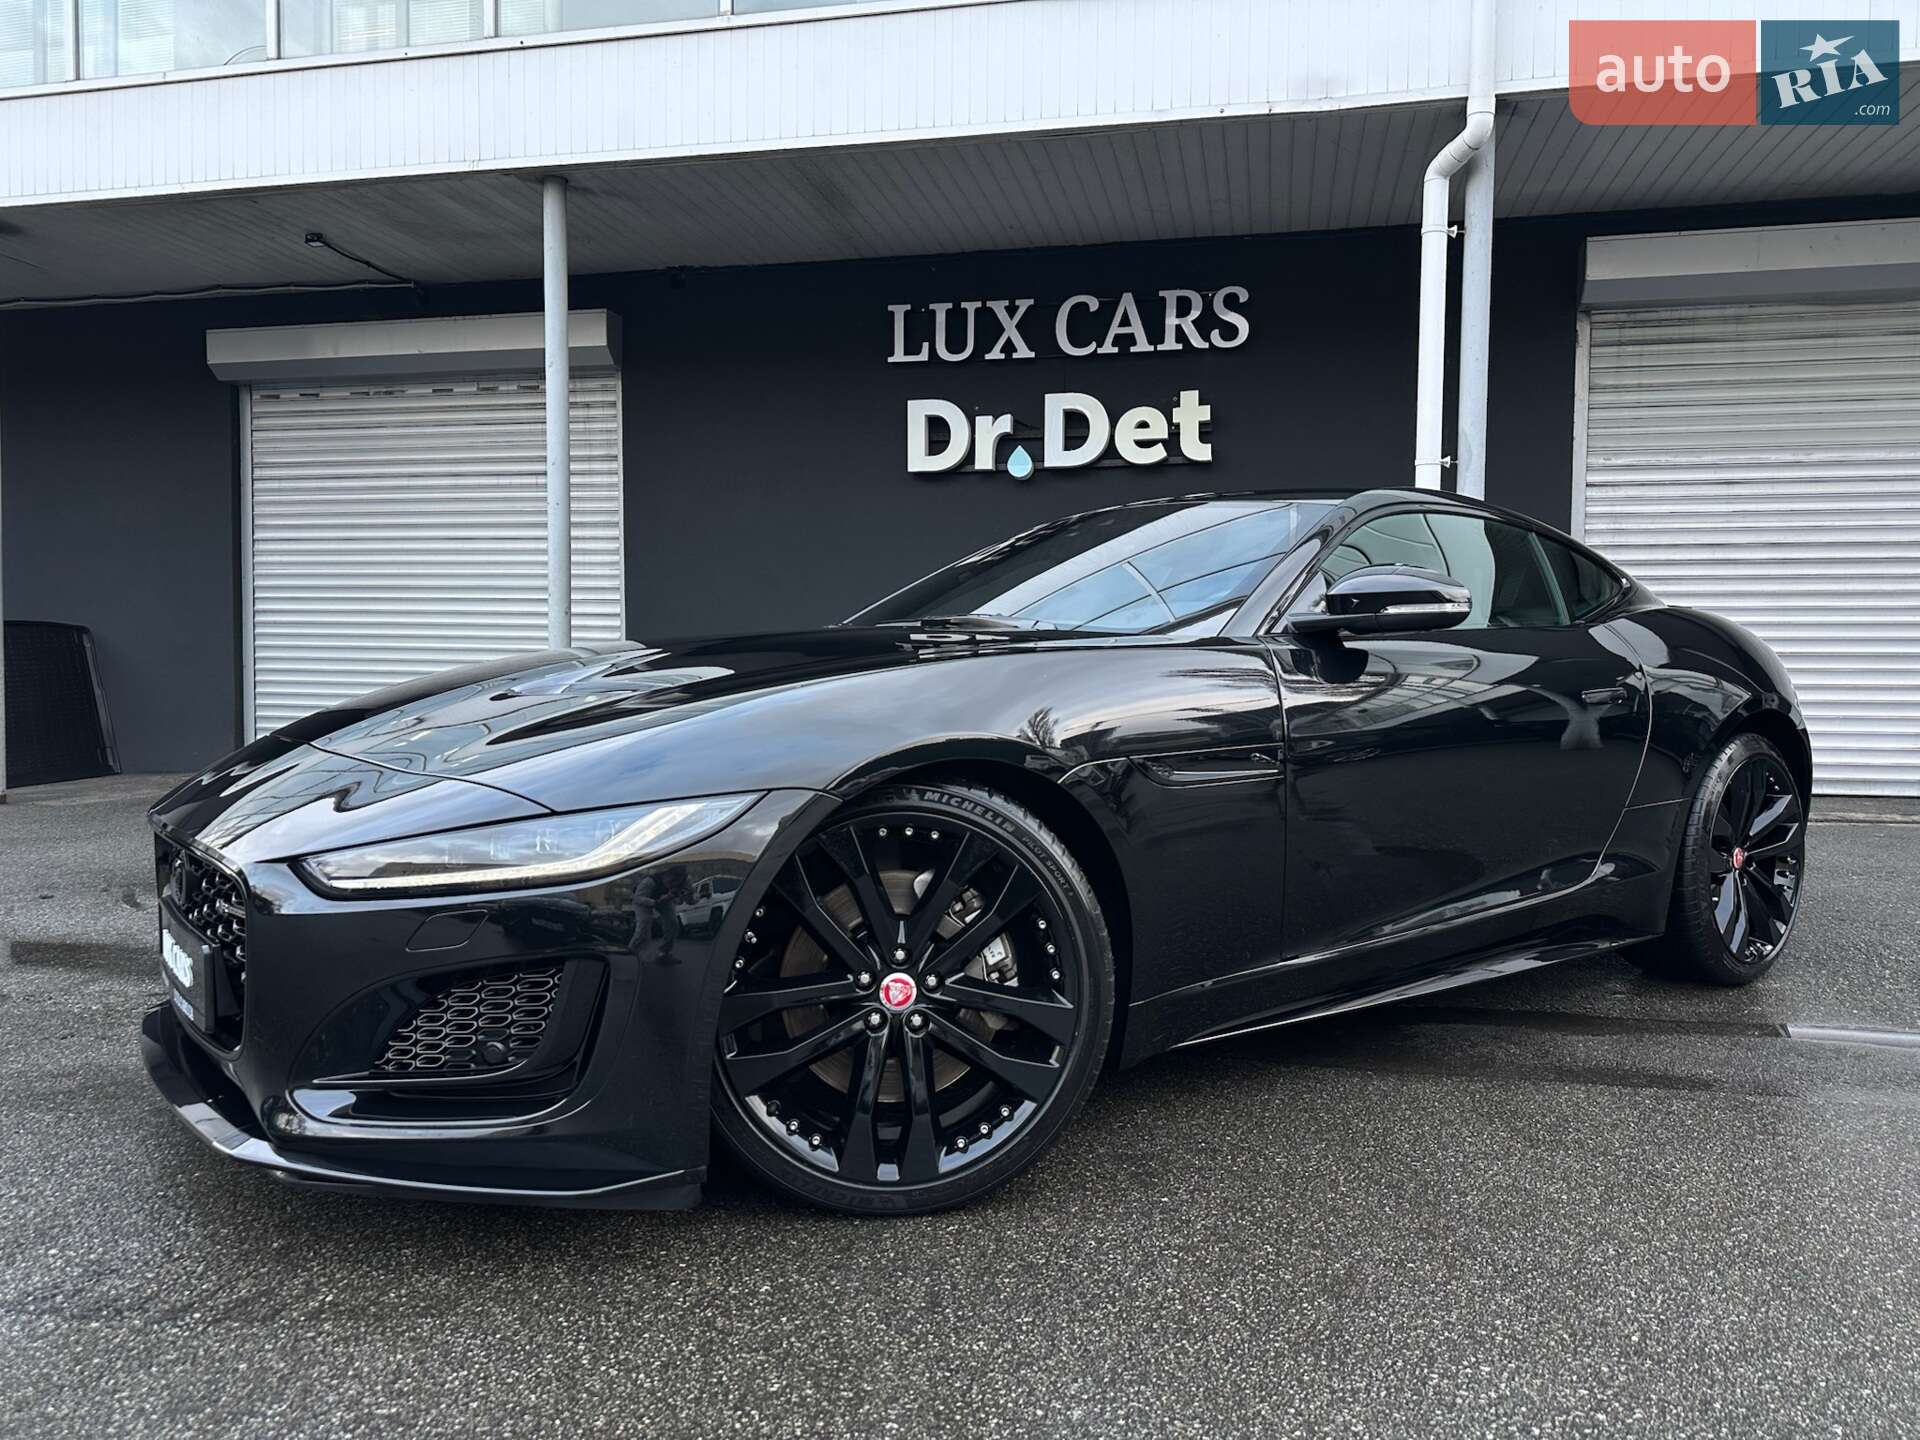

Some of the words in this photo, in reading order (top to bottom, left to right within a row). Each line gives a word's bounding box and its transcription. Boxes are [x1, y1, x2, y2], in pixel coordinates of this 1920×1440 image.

[887, 298, 1035, 363] LUX
[1055, 286, 1250, 356] CARS
[923, 791, 1017, 833] MICHELIN
[1045, 860, 1071, 889] SPORT
